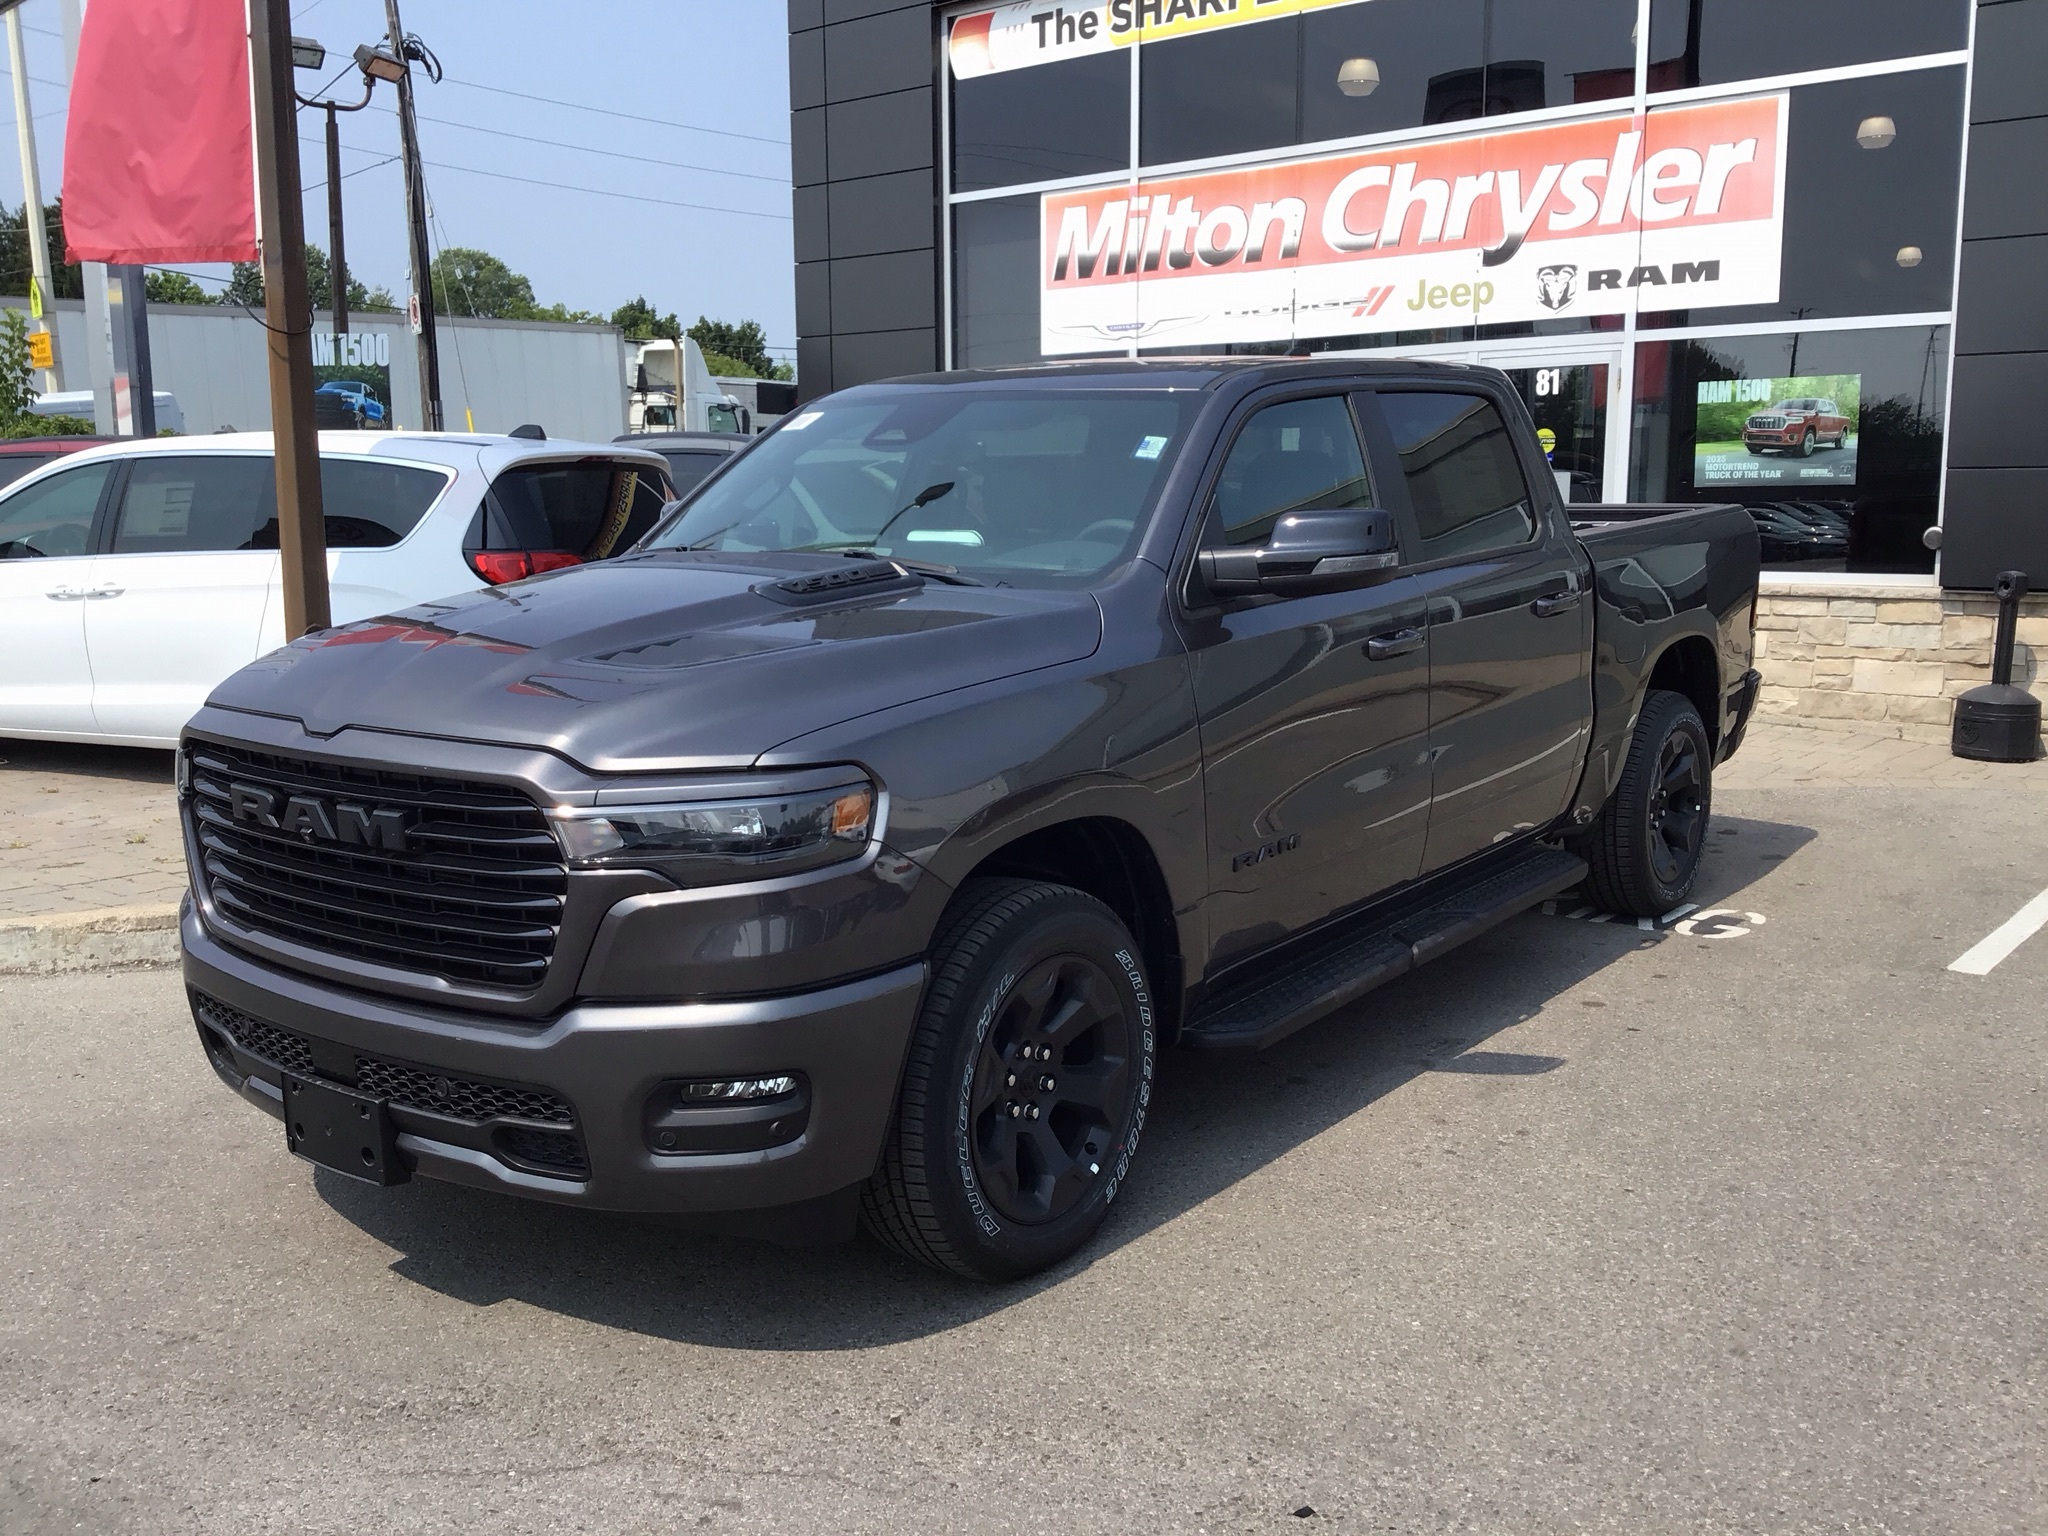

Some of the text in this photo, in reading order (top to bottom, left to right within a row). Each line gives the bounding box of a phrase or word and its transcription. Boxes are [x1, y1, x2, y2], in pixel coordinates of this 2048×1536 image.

[1032, 6, 1099, 50] The
[1053, 130, 1758, 282] Milton Chrysler
[1587, 259, 1721, 292] RAM
[1406, 279, 1495, 314] Jeep
[339, 333, 390, 367] 1500
[1535, 368, 1561, 397] 81
[1697, 379, 1772, 404] RAM 1500
[1705, 462, 1759, 471] MOTORTREND
[1705, 471, 1731, 480] TRUCK
[1732, 471, 1743, 479] OF
[1744, 470, 1759, 479] THE
[1706, 455, 1727, 463] 2025
[230, 781, 406, 851] RAM
[1231, 832, 1303, 873] RAM
[1105, 949, 1155, 1205] BRIDGESTONE
